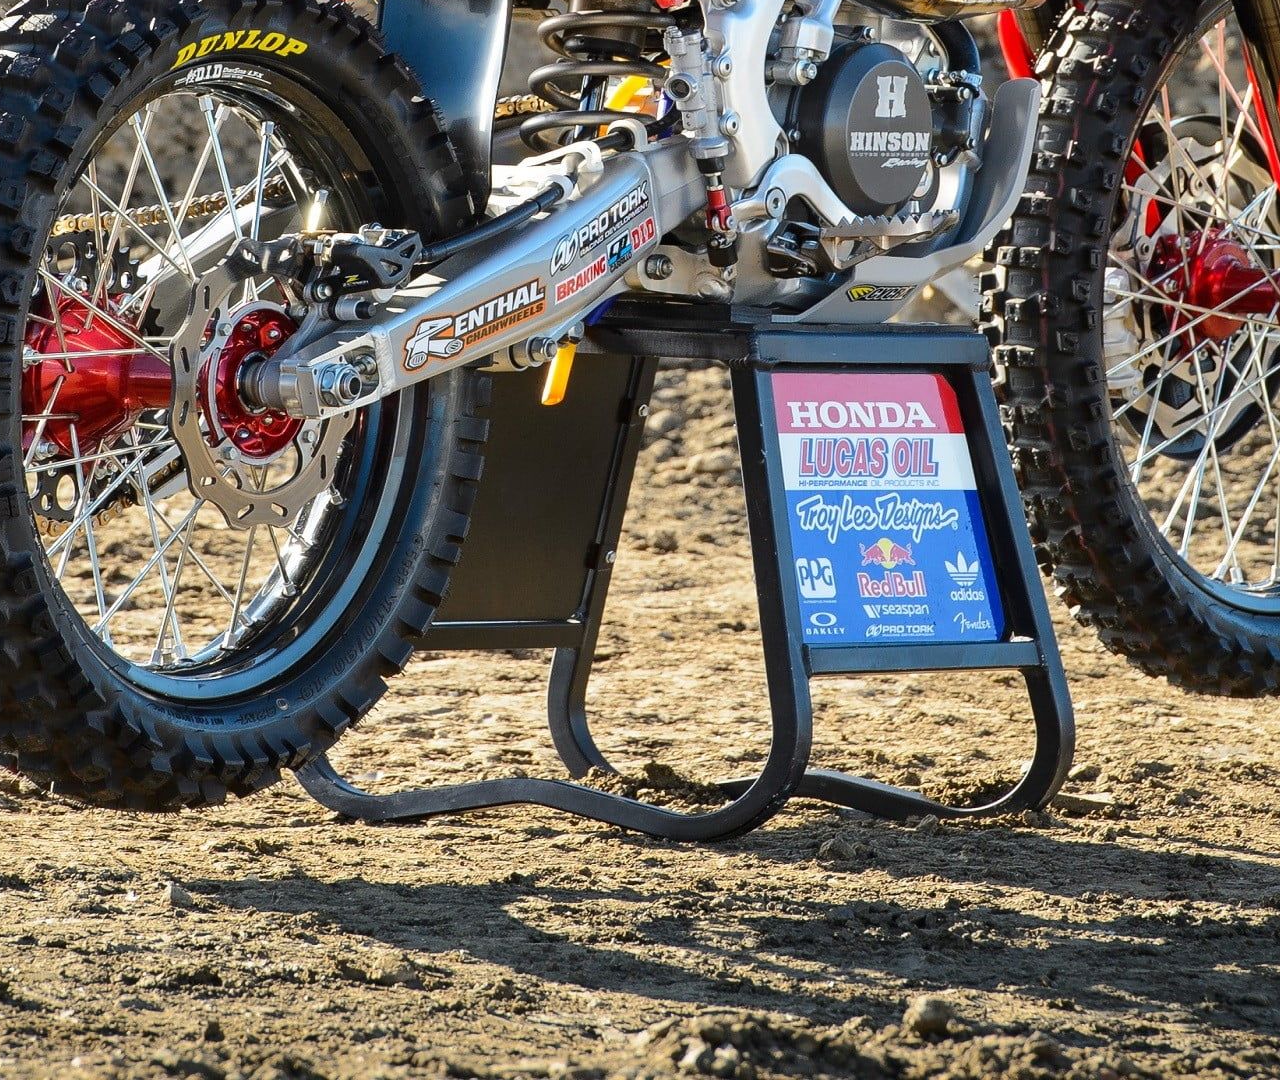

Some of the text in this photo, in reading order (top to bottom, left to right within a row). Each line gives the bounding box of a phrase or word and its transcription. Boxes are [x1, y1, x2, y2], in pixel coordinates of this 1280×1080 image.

[169, 29, 309, 71] DUNLOP
[875, 75, 908, 118] H
[850, 131, 931, 151] HINSON
[579, 180, 649, 248] PRO TORK
[580, 200, 649, 258] RACING DEVELOPMENT
[557, 256, 607, 302] BRAKING
[404, 281, 545, 370] RENTHAL
[466, 302, 544, 346] CHAINWHEELS
[786, 400, 937, 428] HONDA
[799, 437, 940, 478] LUCAS OIL
[870, 479, 882, 487] OIL
[884, 479, 925, 487] PRODUCTS
[796, 492, 959, 544] Troy Lee Designs
[857, 570, 928, 598] Red Bull
[950, 589, 985, 601] adidas
[882, 604, 929, 617] seaspan
[953, 611, 992, 633] Fender
[806, 627, 845, 635] OAKLEY
[882, 624, 935, 633] PRO TORK
